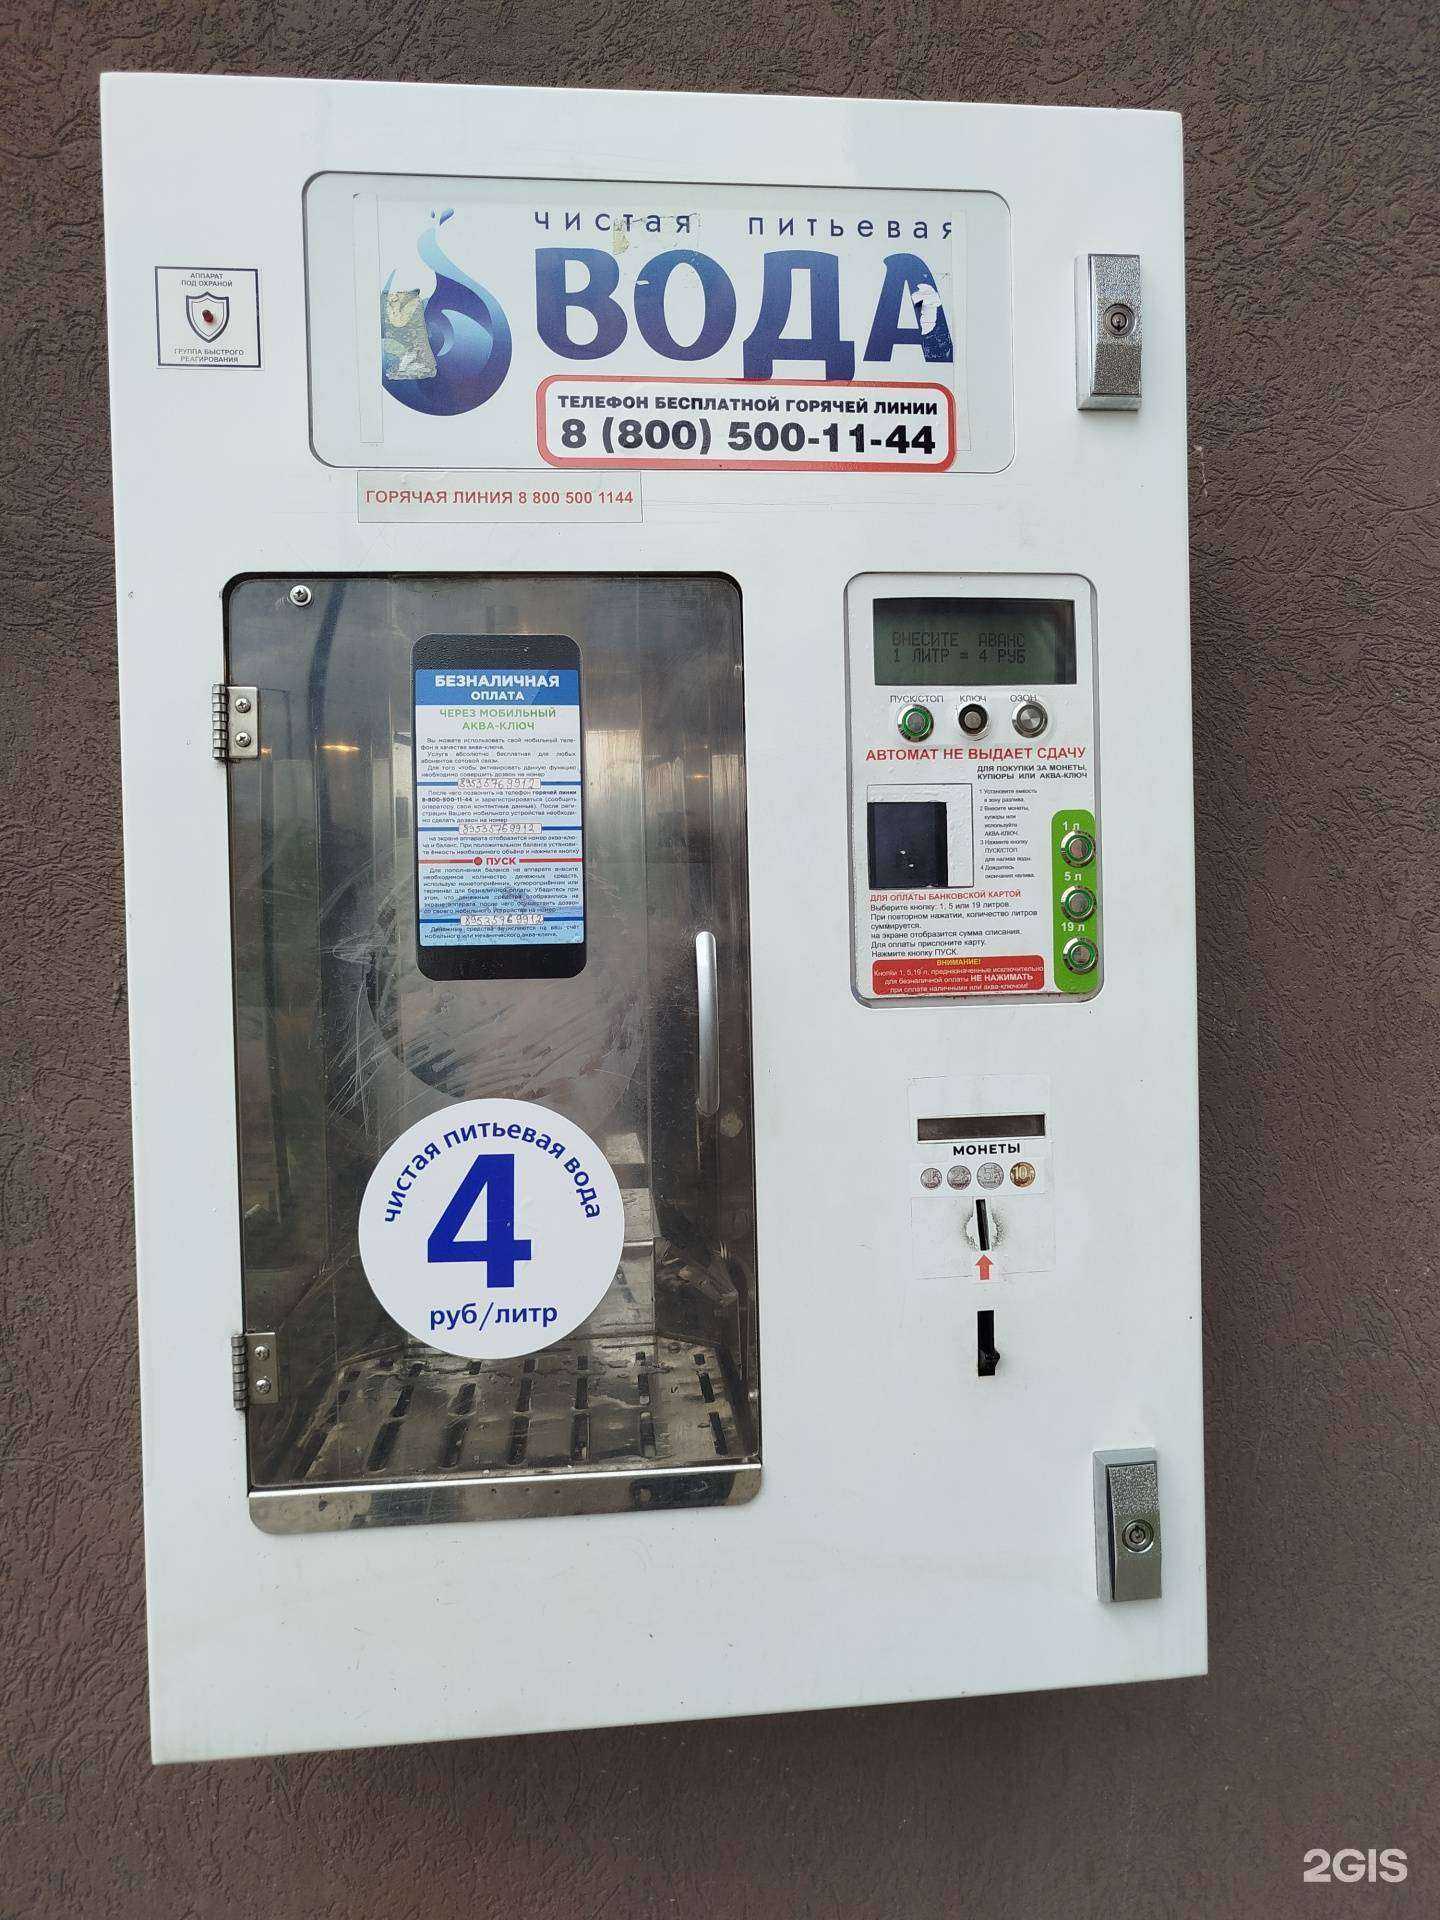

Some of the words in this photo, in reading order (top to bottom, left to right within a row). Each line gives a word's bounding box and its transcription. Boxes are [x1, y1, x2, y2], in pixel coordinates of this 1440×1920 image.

[535, 247, 954, 381] ВОДА
[174, 348, 202, 356] ГРУППА
[558, 395, 649, 409] ТЕЛЕФОН
[655, 396, 779, 412] БЕСПЛАТНОЙ
[786, 398, 868, 413] ГОРЯЧЕЙ
[874, 401, 938, 415] ЛИНИИ
[561, 418, 587, 449] 8
[602, 416, 712, 455] (800)
[728, 421, 936, 454] 500-11-44
[366, 490, 447, 504] ГОРЯЧАЯ
[453, 491, 513, 504] ЛИНИЯ
[518, 491, 527, 504] 8
[532, 491, 560, 504] 800
[565, 491, 593, 504] 500
[599, 491, 634, 504] 1144
[892, 632, 960, 647] ВНЕСИТЕ
[979, 632, 1025, 648] АВАНС
[894, 648, 900, 662] 1
[912, 648, 950, 664] ЛИТР
[960, 651, 969, 660] =
[979, 648, 988, 662] 4
[998, 648, 1026, 664] РУБ
[435, 675, 560, 688] БЕЗНАЛИЧНАЯ
[471, 691, 525, 701] ОПЛАТА
[890, 695, 944, 703] ПУСК/СТОП
[959, 695, 987, 703] КЛЮЧ
[1010, 694, 1038, 702] ОЗОН
[440, 709, 477, 718] ЧЕРЕЗ
[480, 707, 556, 718] МОБИЛЬНЫЙ
[462, 721, 535, 731] АКВА-КЛЮЧ
[866, 749, 938, 761] АВТОМАТ
[943, 749, 963, 760] НЕ
[968, 748, 1033, 761] ВЫДАЕТ
[1037, 747, 1086, 760] СДАЧУ
[1049, 764, 1087, 772] МОНЕТЫ,
[1063, 821, 1068, 831] 1
[1072, 823, 1080, 831] л
[486, 857, 517, 866] ПУСК
[1064, 871, 1071, 881] 5
[1074, 873, 1082, 881] л
[870, 894, 888, 902] ДЛЯ
[890, 893, 927, 901] ОПЛАТЫ
[929, 891, 986, 900] БАНКОВСКОЙ
[989, 890, 1021, 898] КАРТОЙ
[871, 904, 908, 912] Выберите
[871, 913, 886, 921] При
[887, 913, 929, 921] повторном
[1011, 910, 1038, 918] литров
[871, 923, 922, 931] суммируется.
[1061, 922, 1074, 932] 19
[1077, 923, 1085, 932] л
[910, 931, 957, 939] отобразится
[918, 940, 962, 948] прислоните
[964, 939, 986, 947] карту.
[871, 950, 906, 958] Нажмите
[936, 958, 981, 966] ВНИМАНИЕ!
[970, 974, 983, 982] НЕ
[984, 973, 1034, 981] НАЖИМАТЬ
[953, 1143, 1021, 1156] МОНЕТЫ
[385, 1142, 441, 1223] чистая
[443, 1122, 566, 1160] питьевая
[564, 1157, 601, 1219] вода
[1014, 1166, 1028, 1180] 10
[427, 1154, 532, 1288] 4
[430, 1302, 558, 1331] руб/литр
